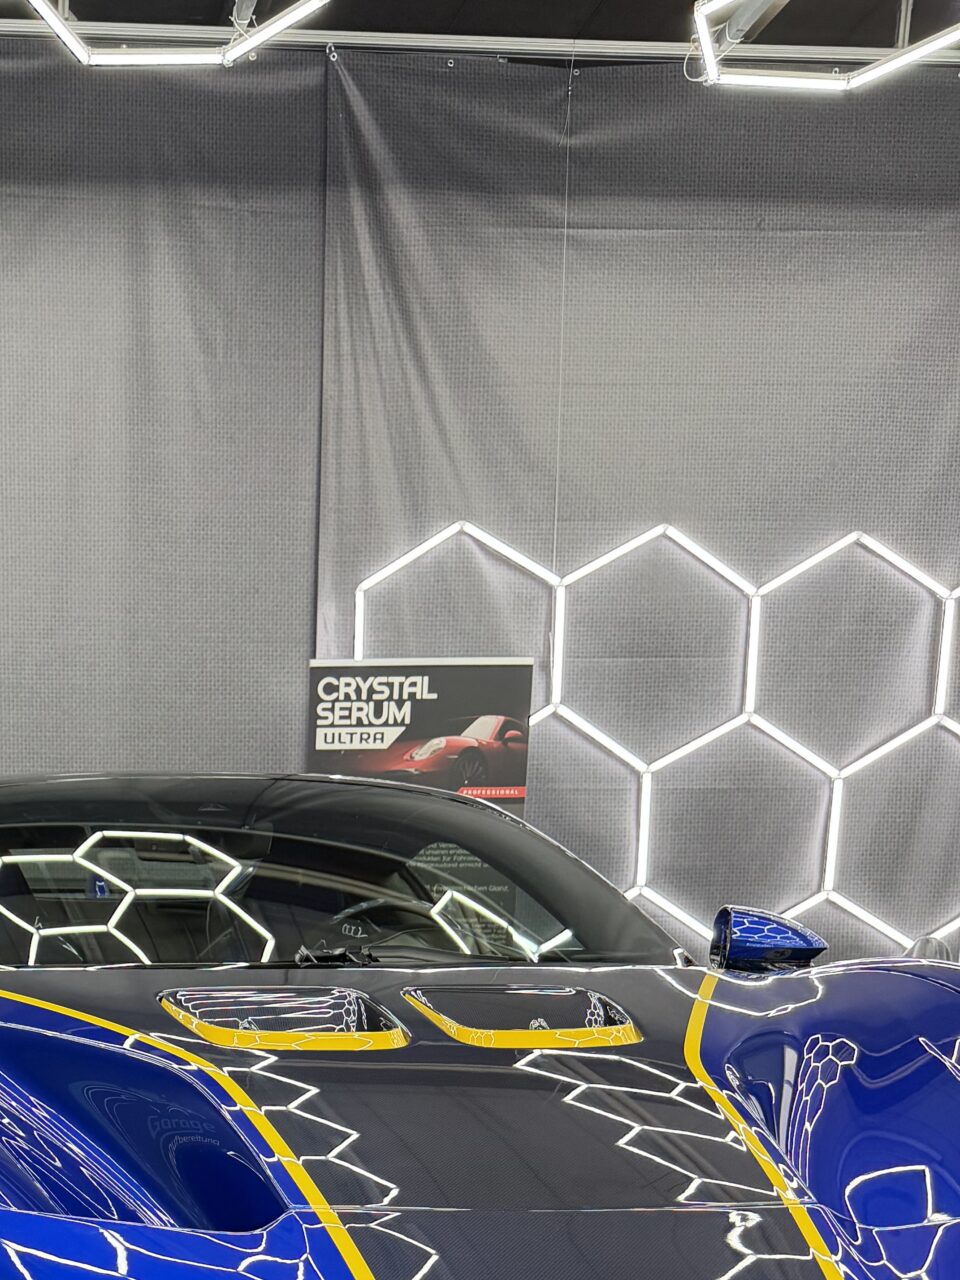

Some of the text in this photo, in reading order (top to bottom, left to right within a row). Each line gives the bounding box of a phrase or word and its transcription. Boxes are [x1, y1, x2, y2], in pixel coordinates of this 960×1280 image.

[317, 675, 438, 701] CRYSTAL
[316, 701, 411, 726] SERUM
[324, 731, 384, 744] ULTRA
[147, 1115, 217, 1139] Garage
